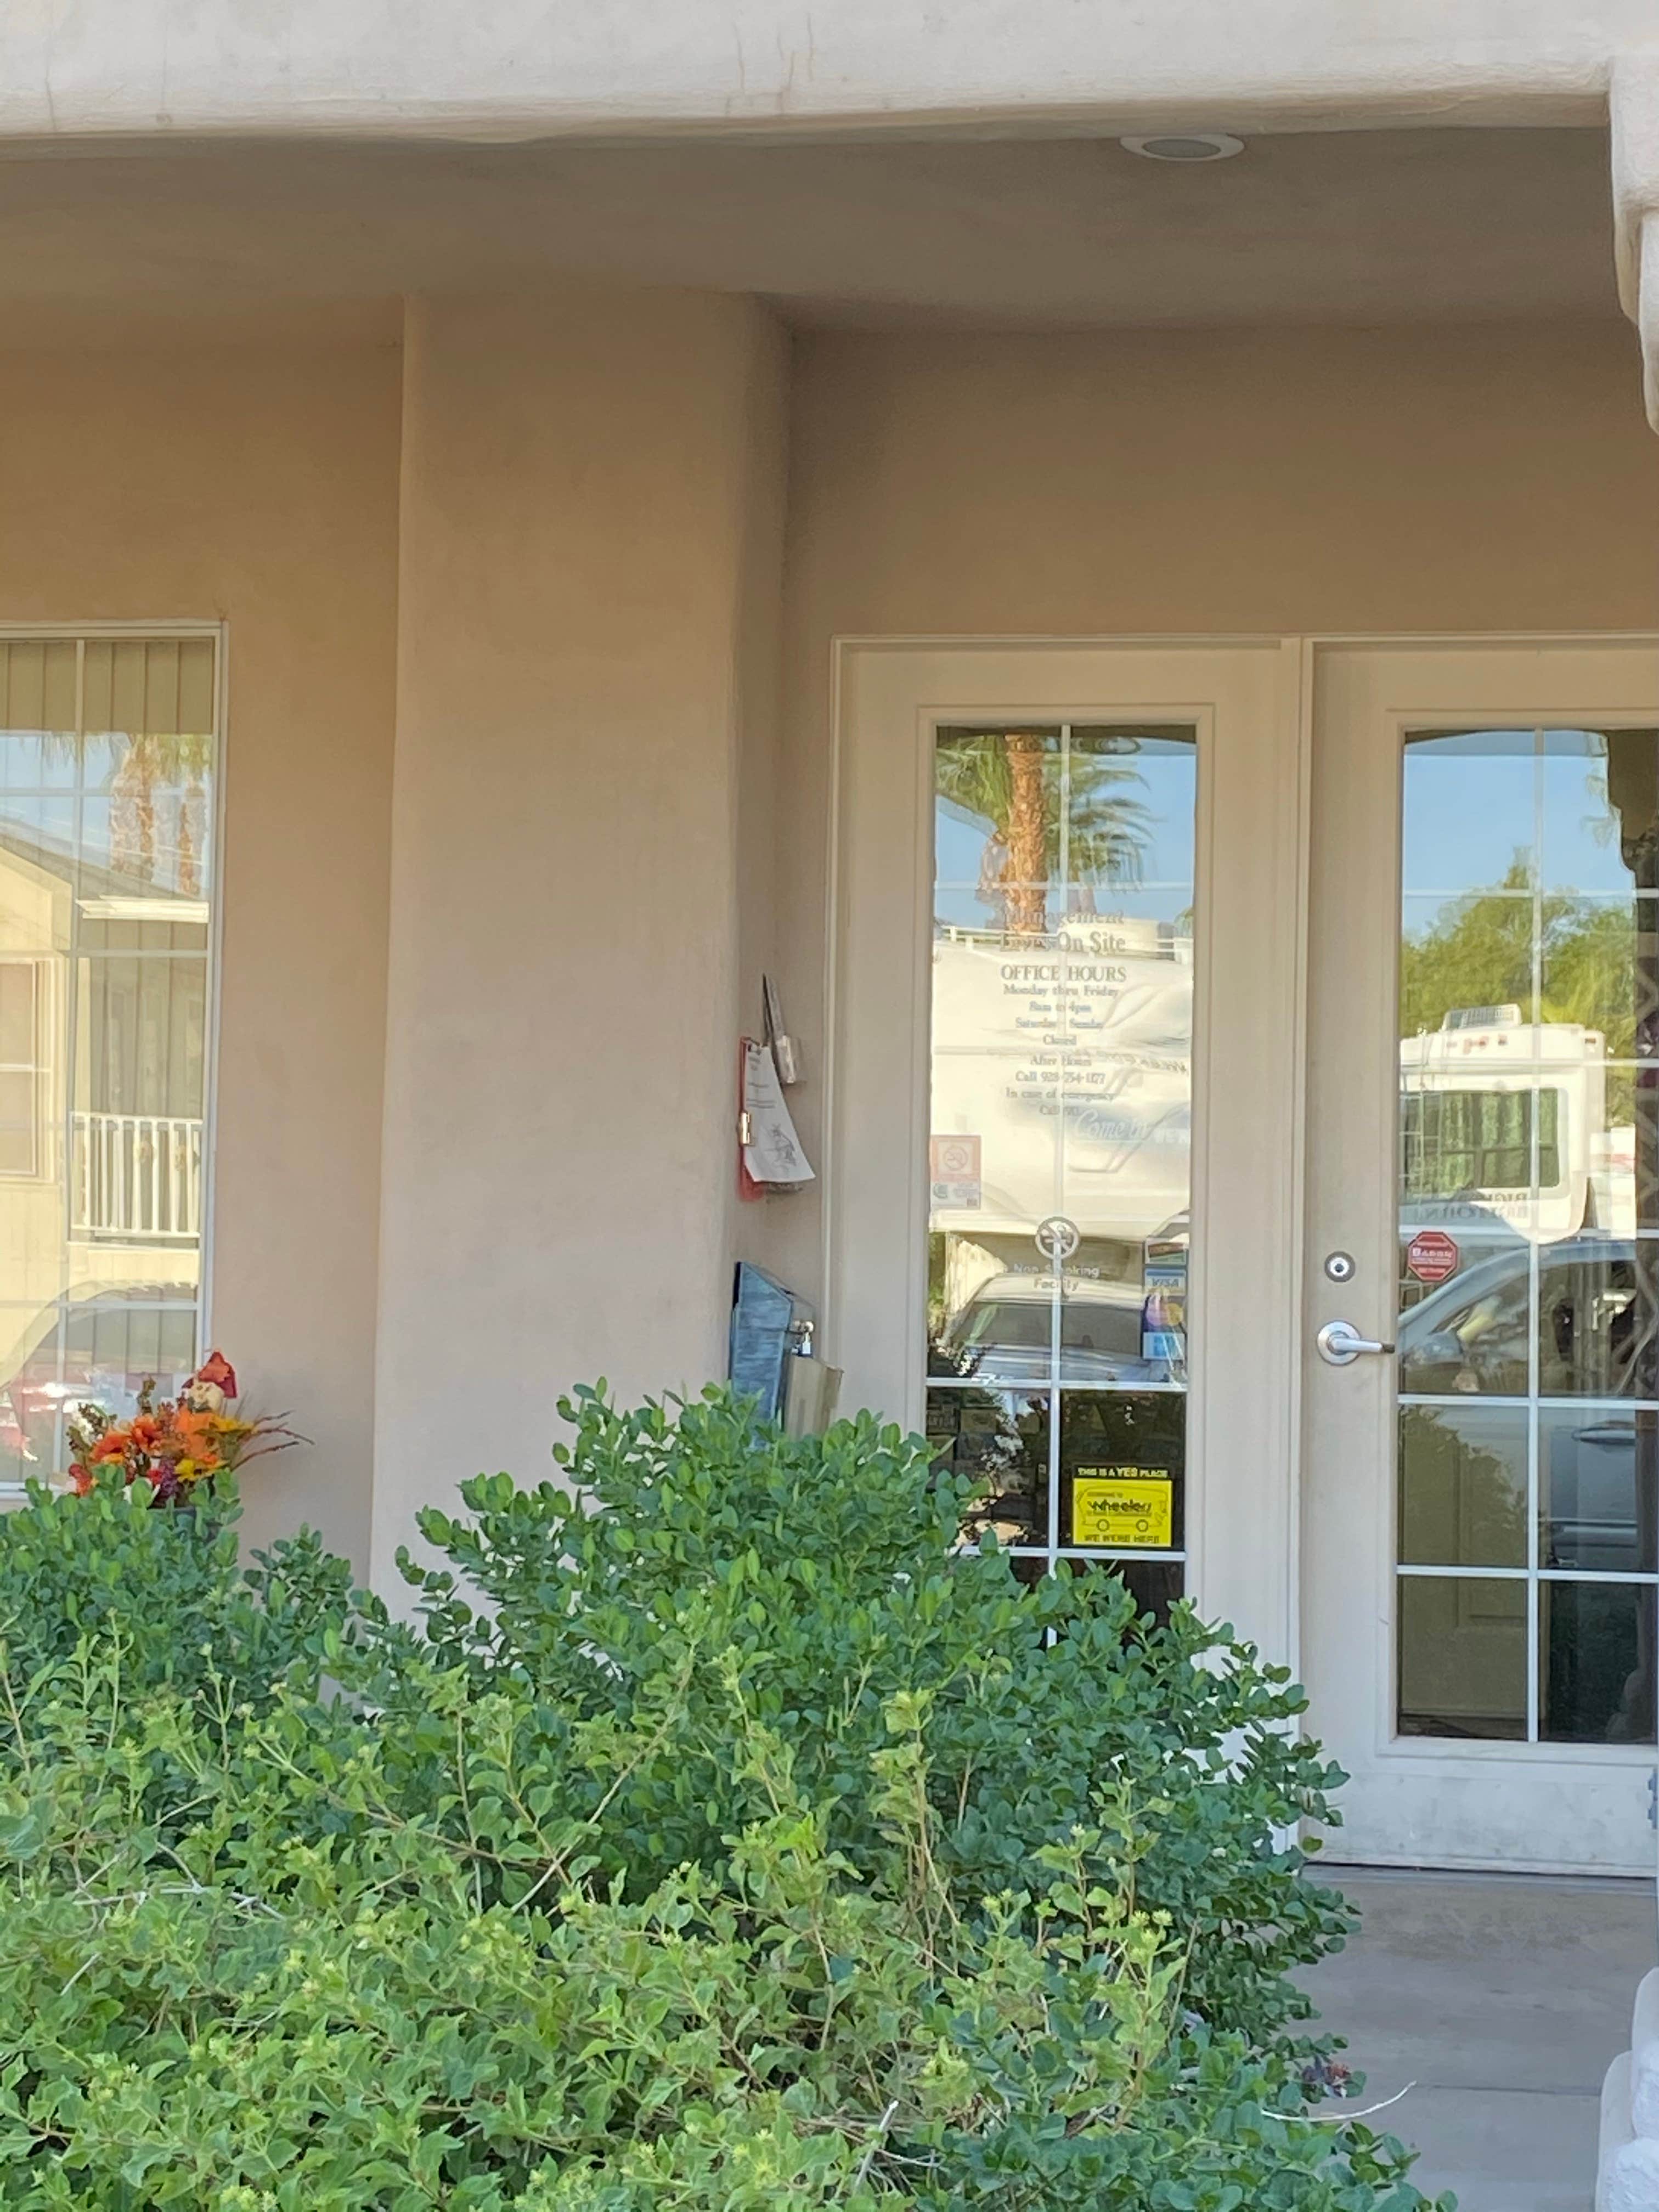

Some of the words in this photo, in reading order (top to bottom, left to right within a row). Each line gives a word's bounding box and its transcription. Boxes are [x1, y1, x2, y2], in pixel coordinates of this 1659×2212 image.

[1058, 932, 1084, 952] On
[1089, 932, 1126, 952] Site
[1001, 964, 1059, 980] OFFICE
[1068, 966, 1127, 983] HOURS
[1003, 984, 1048, 997] Monday
[1052, 984, 1079, 995] thru
[1084, 985, 1119, 999] Friday
[1075, 1108, 1125, 1140] Come
[1045, 1264, 1100, 1279] Soking
[1152, 1278, 1179, 1287] VISA
[1108, 1468, 1115, 1477] A
[1116, 1467, 1138, 1477] YES
